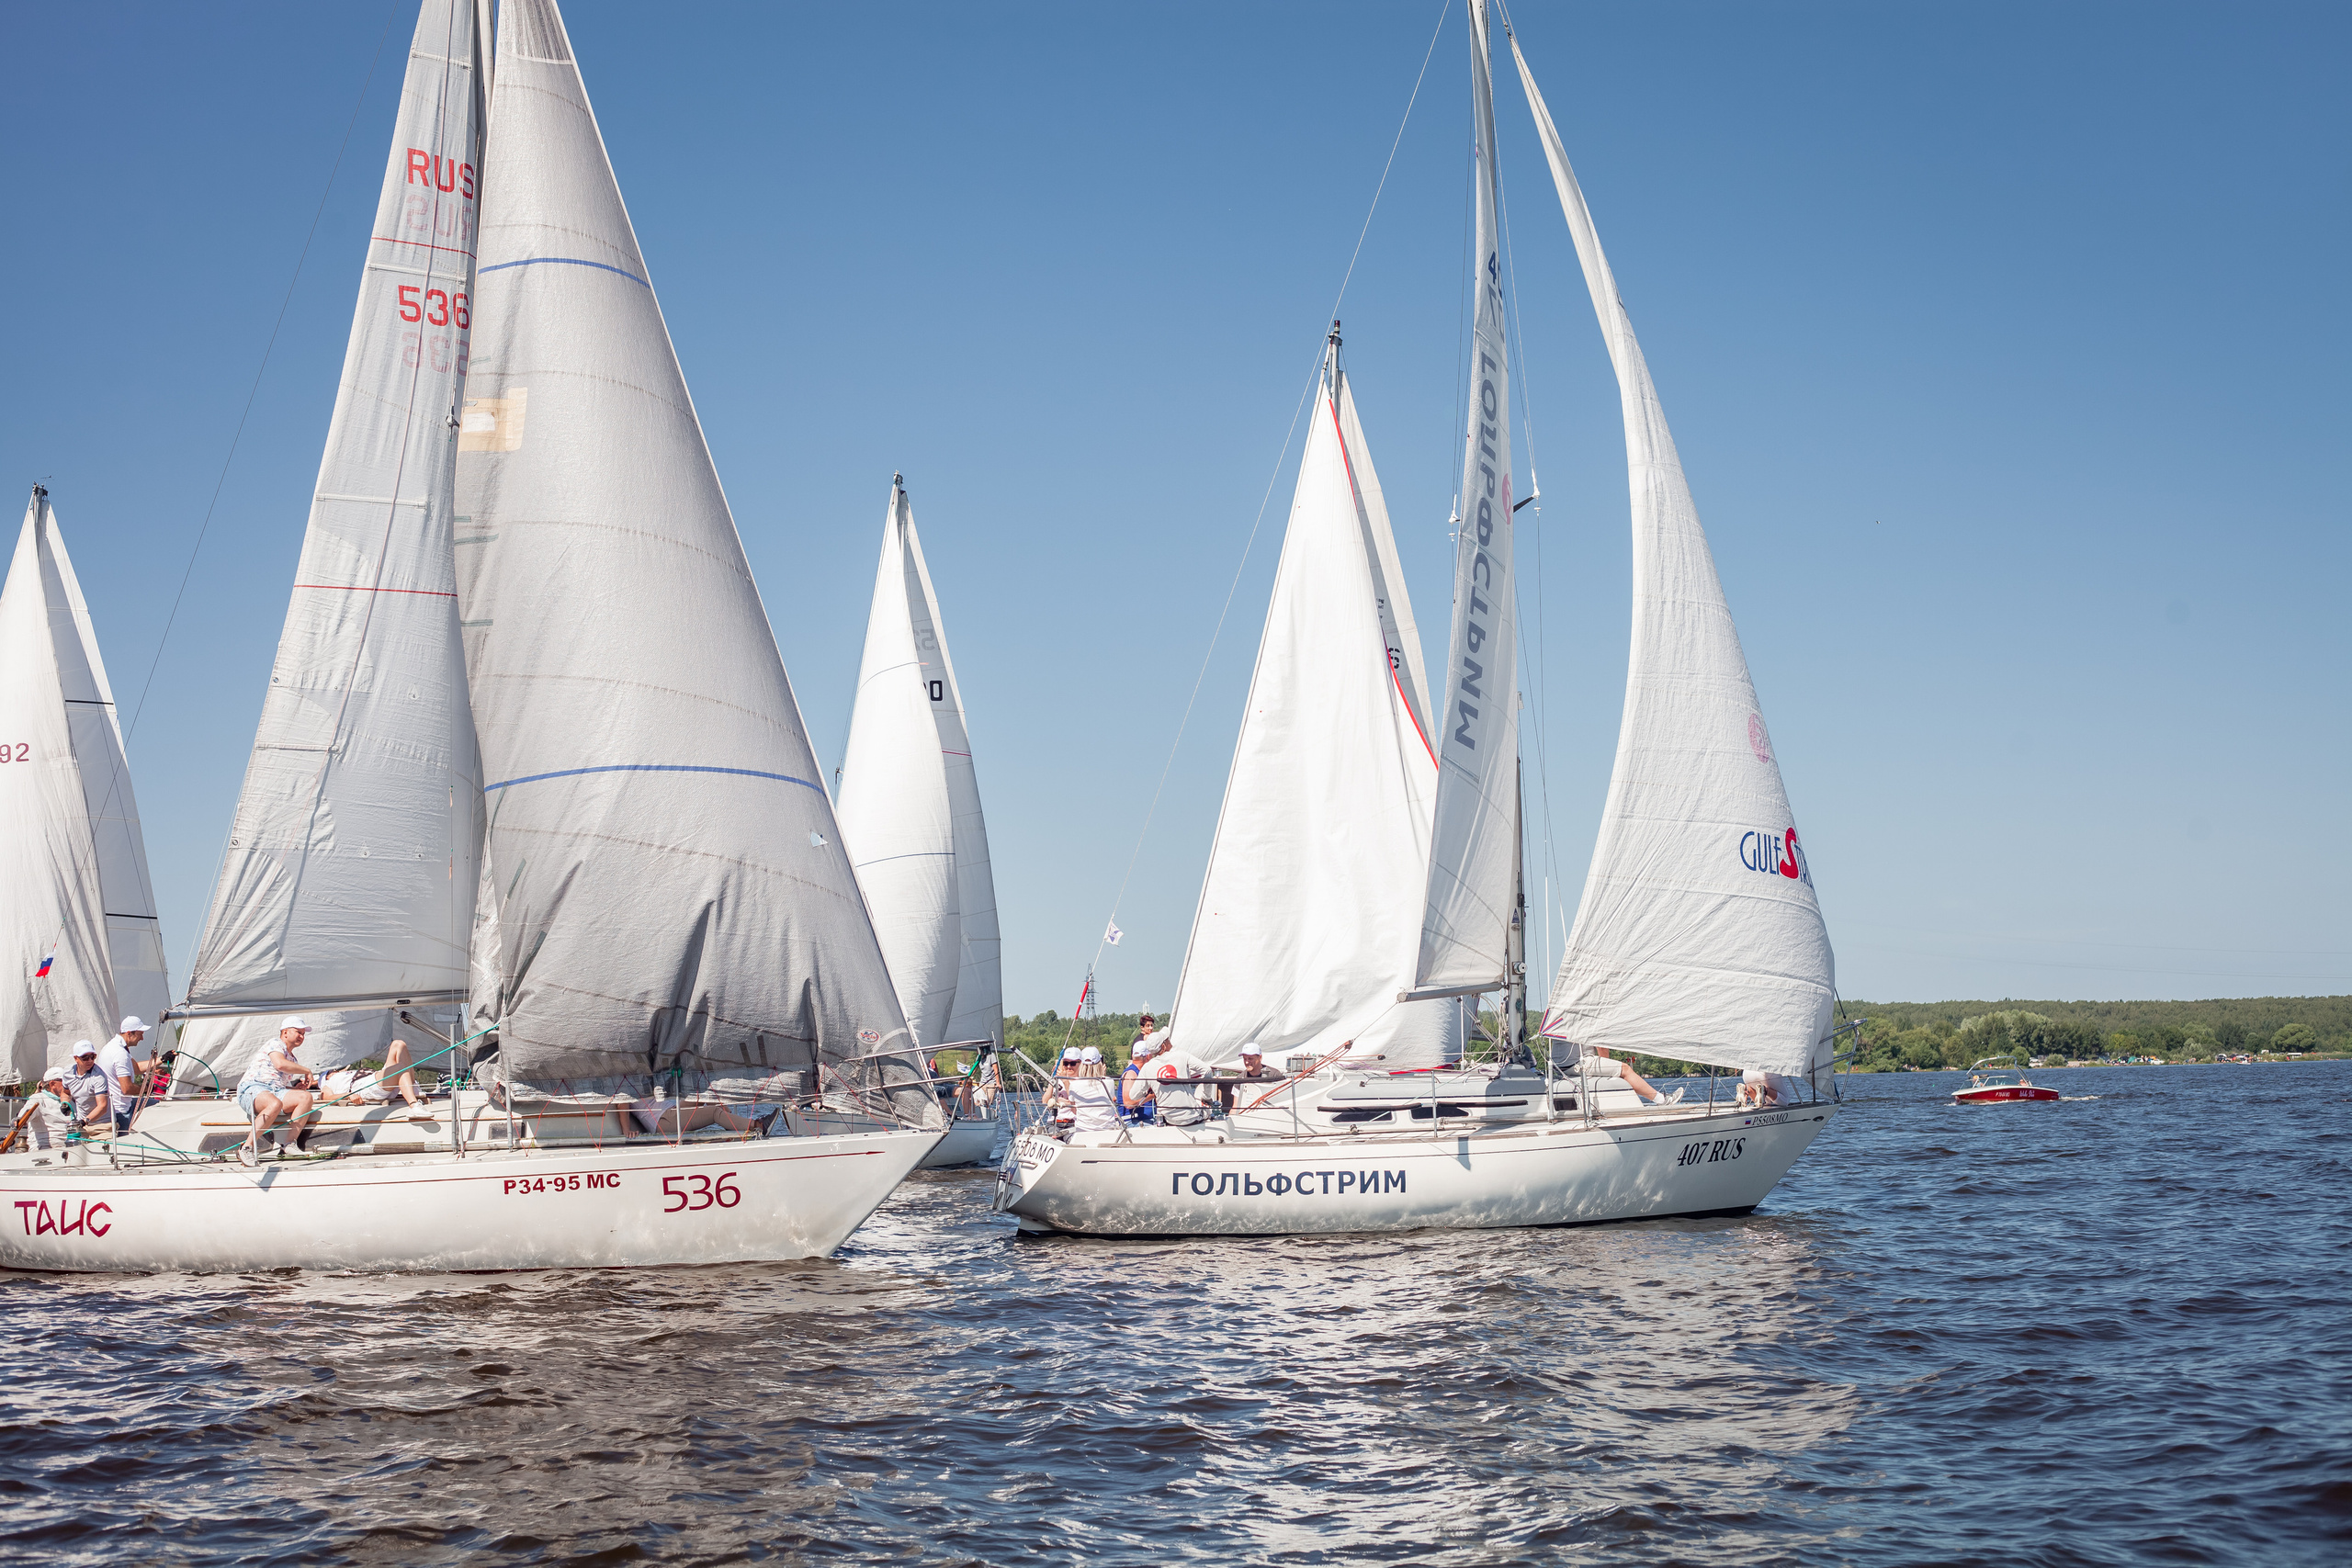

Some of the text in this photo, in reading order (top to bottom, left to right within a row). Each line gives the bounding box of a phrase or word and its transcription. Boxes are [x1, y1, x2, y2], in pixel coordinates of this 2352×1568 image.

[407, 148, 474, 200] RUS
[398, 285, 469, 330] 536
[1677, 1137, 1747, 1167] 407 RUS
[503, 1172, 621, 1195] Р34-95 МС
[662, 1171, 741, 1213] 536
[1172, 1169, 1407, 1197] ГОЛЬФСТРИМ
[14, 1199, 114, 1238] ТАИС
